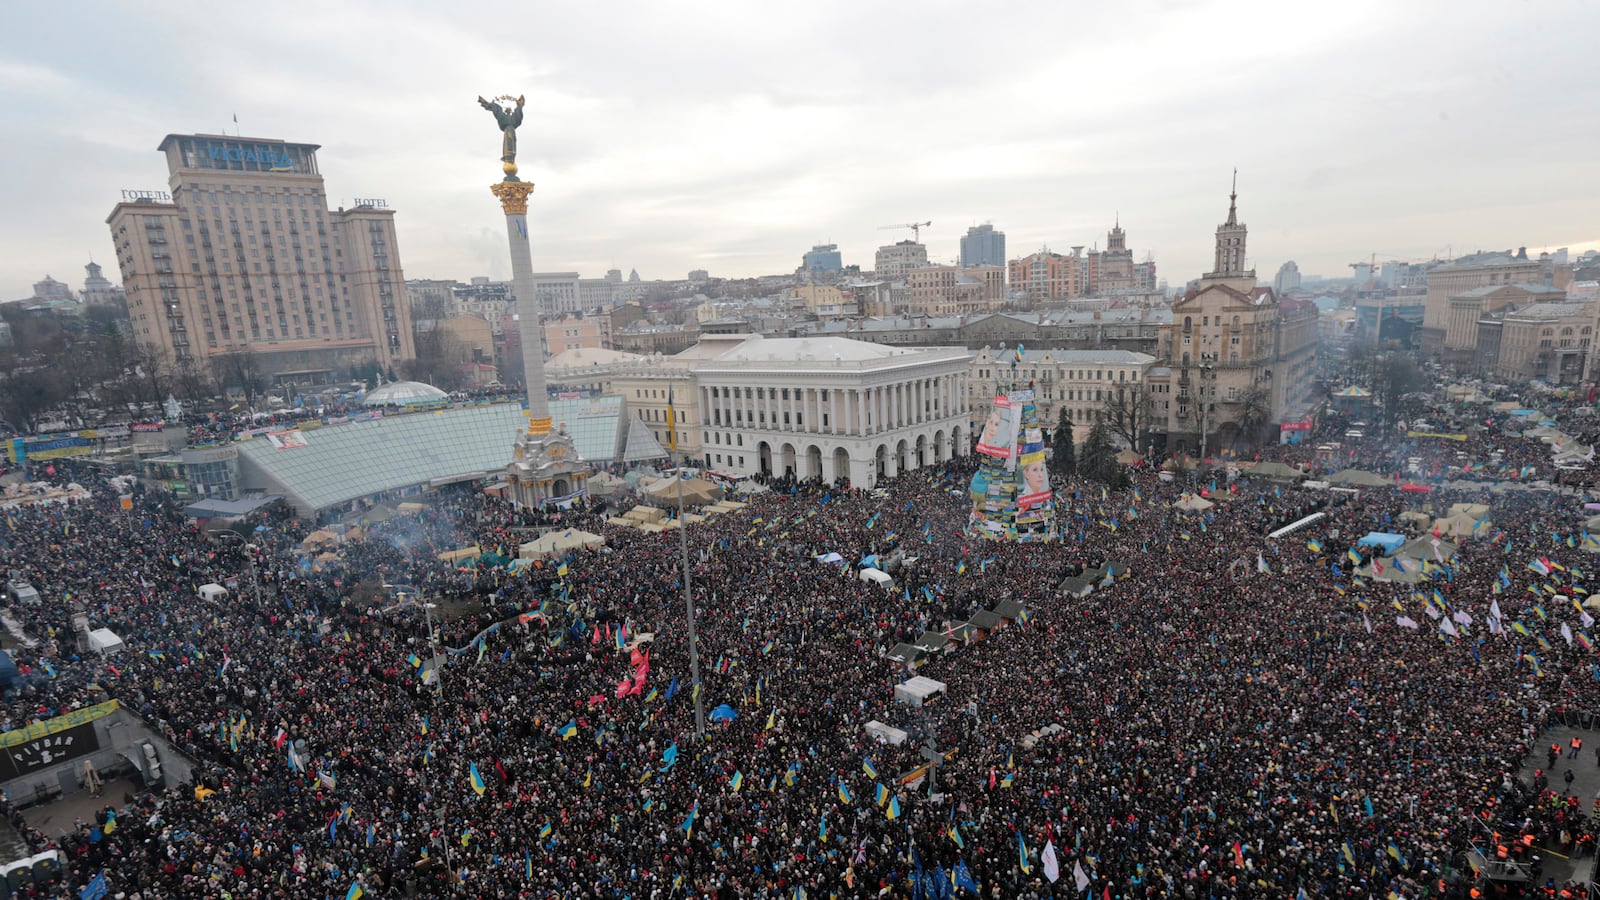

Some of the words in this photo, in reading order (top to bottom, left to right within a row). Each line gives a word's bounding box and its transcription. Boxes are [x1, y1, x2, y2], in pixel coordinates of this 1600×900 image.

[121, 190, 170, 200] ГОТЕЛЬ
[354, 198, 389, 207] HOTEL
[14, 736, 73, 761] PIVBAR
